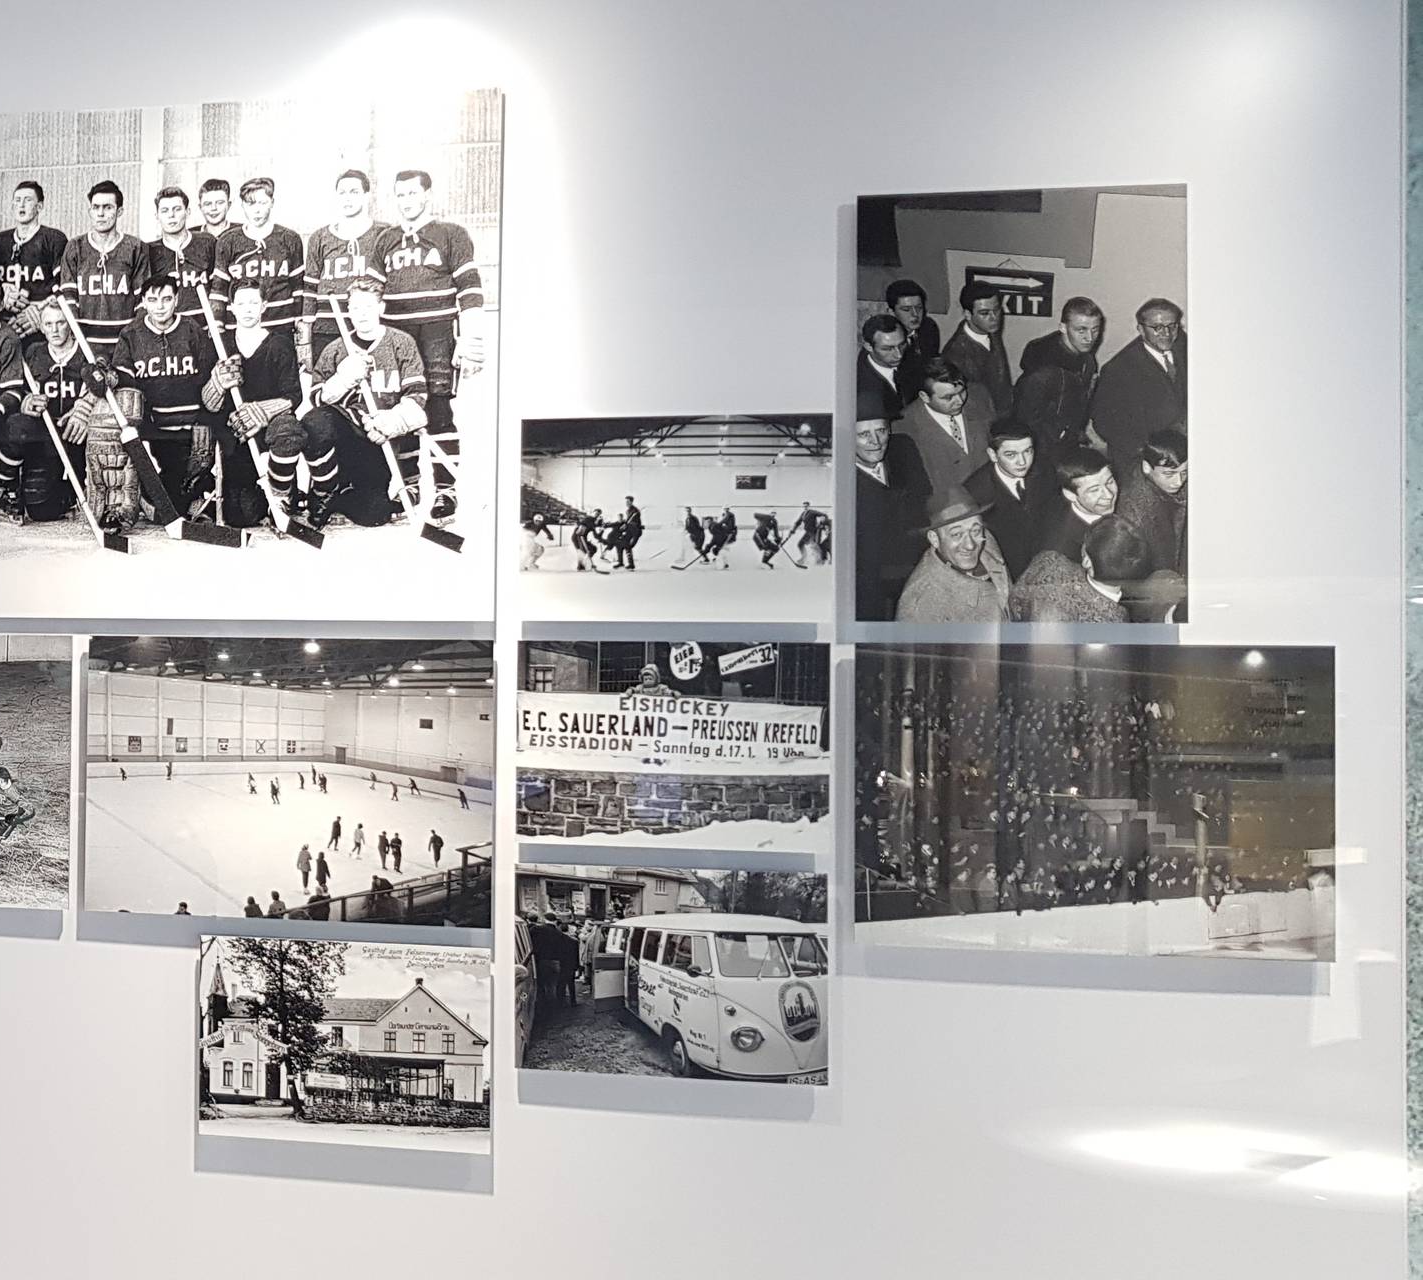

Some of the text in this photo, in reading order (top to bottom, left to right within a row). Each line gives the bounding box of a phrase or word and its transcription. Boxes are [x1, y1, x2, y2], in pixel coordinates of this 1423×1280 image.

[228, 260, 289, 280] RCHA
[619, 696, 730, 717] EISHOCKEY
[522, 710, 553, 733] E.C.
[558, 712, 668, 738] SAUERLAND
[691, 718, 759, 742] PREUSSEN
[763, 722, 818, 745] KREFELD
[529, 733, 633, 752] EISSTADION
